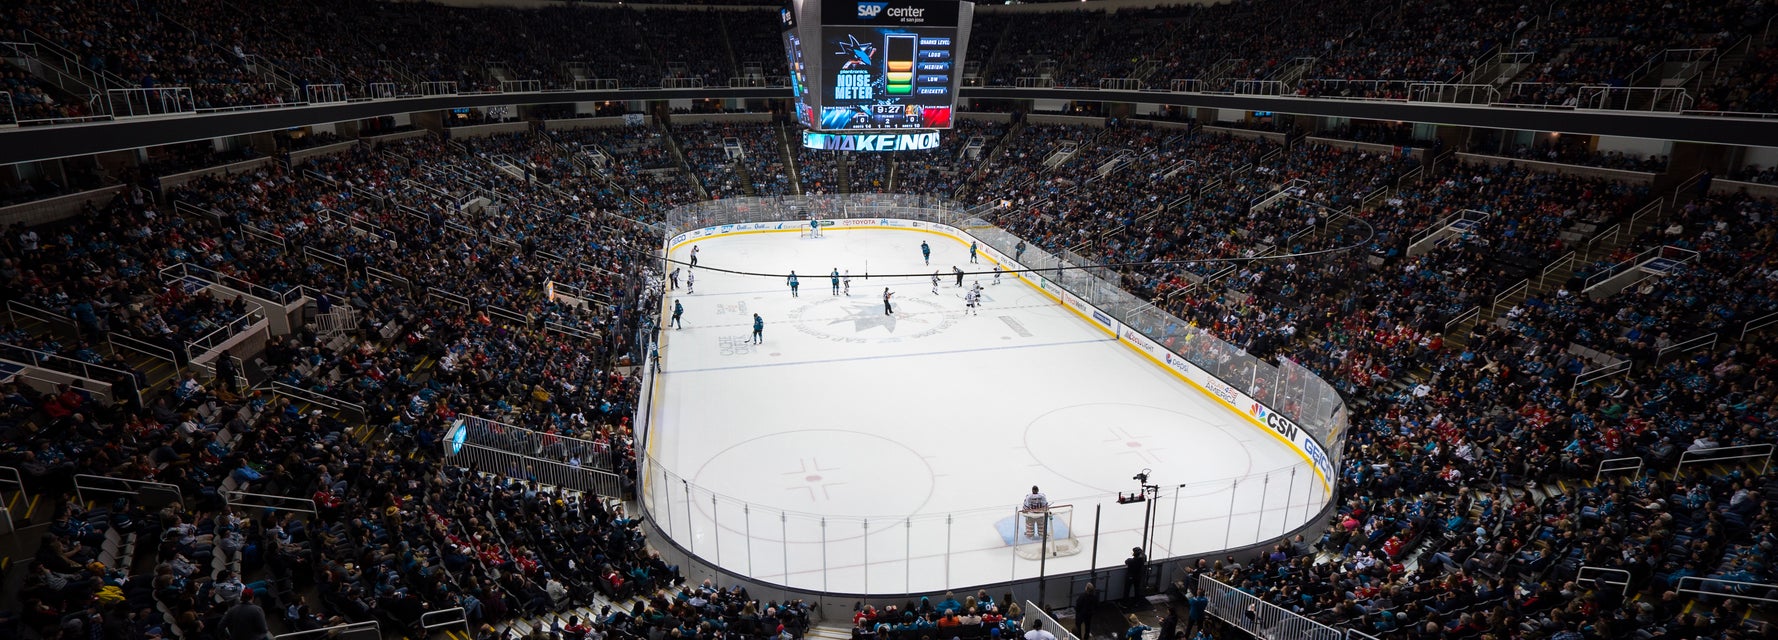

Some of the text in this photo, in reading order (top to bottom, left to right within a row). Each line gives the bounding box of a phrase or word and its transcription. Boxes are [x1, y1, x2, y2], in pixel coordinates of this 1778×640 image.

[858, 5, 925, 17] SAP center
[837, 74, 871, 86] NOISE
[835, 86, 873, 99] METER
[823, 134, 896, 151] MAKE
[1172, 358, 1189, 372] pepsi
[1205, 382, 1236, 405] AMERICA
[1267, 413, 1298, 442] CSN
[1304, 438, 1332, 482] GEICO
